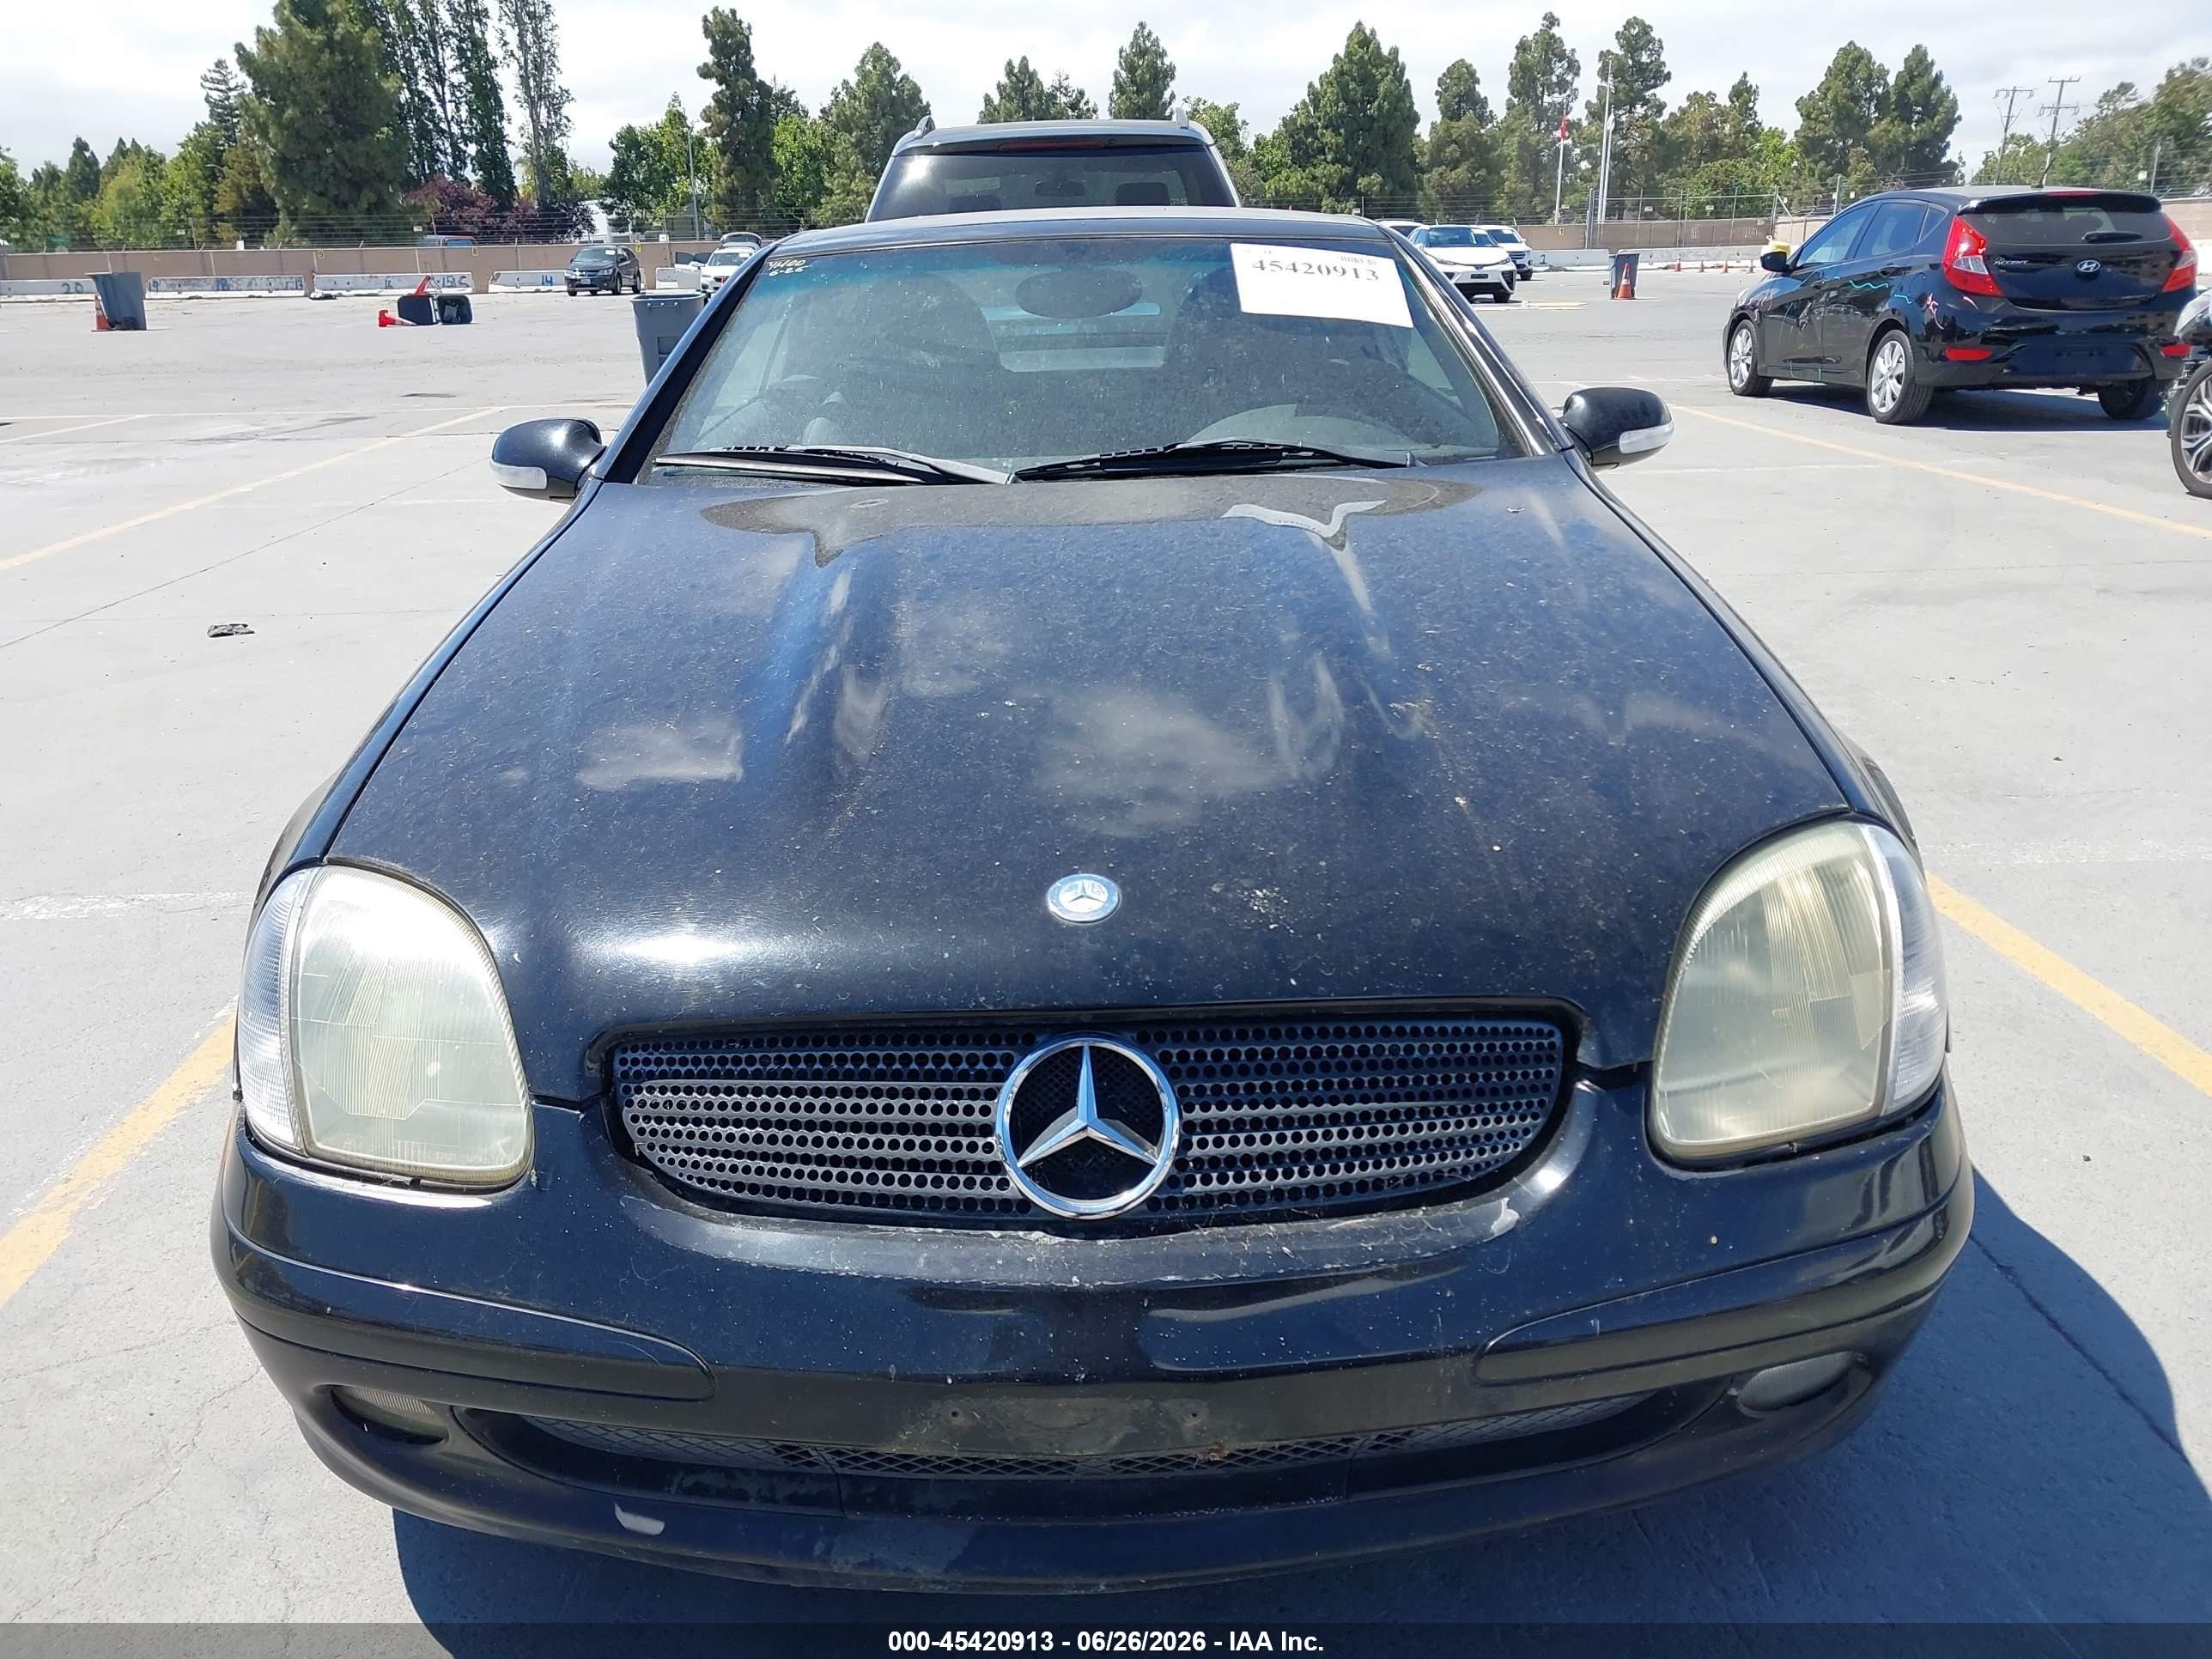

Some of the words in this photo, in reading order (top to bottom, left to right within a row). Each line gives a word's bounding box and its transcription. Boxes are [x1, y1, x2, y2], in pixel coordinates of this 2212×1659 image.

[1253, 259, 1379, 281] 45420913
[541, 275, 553, 286] 14
[61, 282, 84, 295] 20
